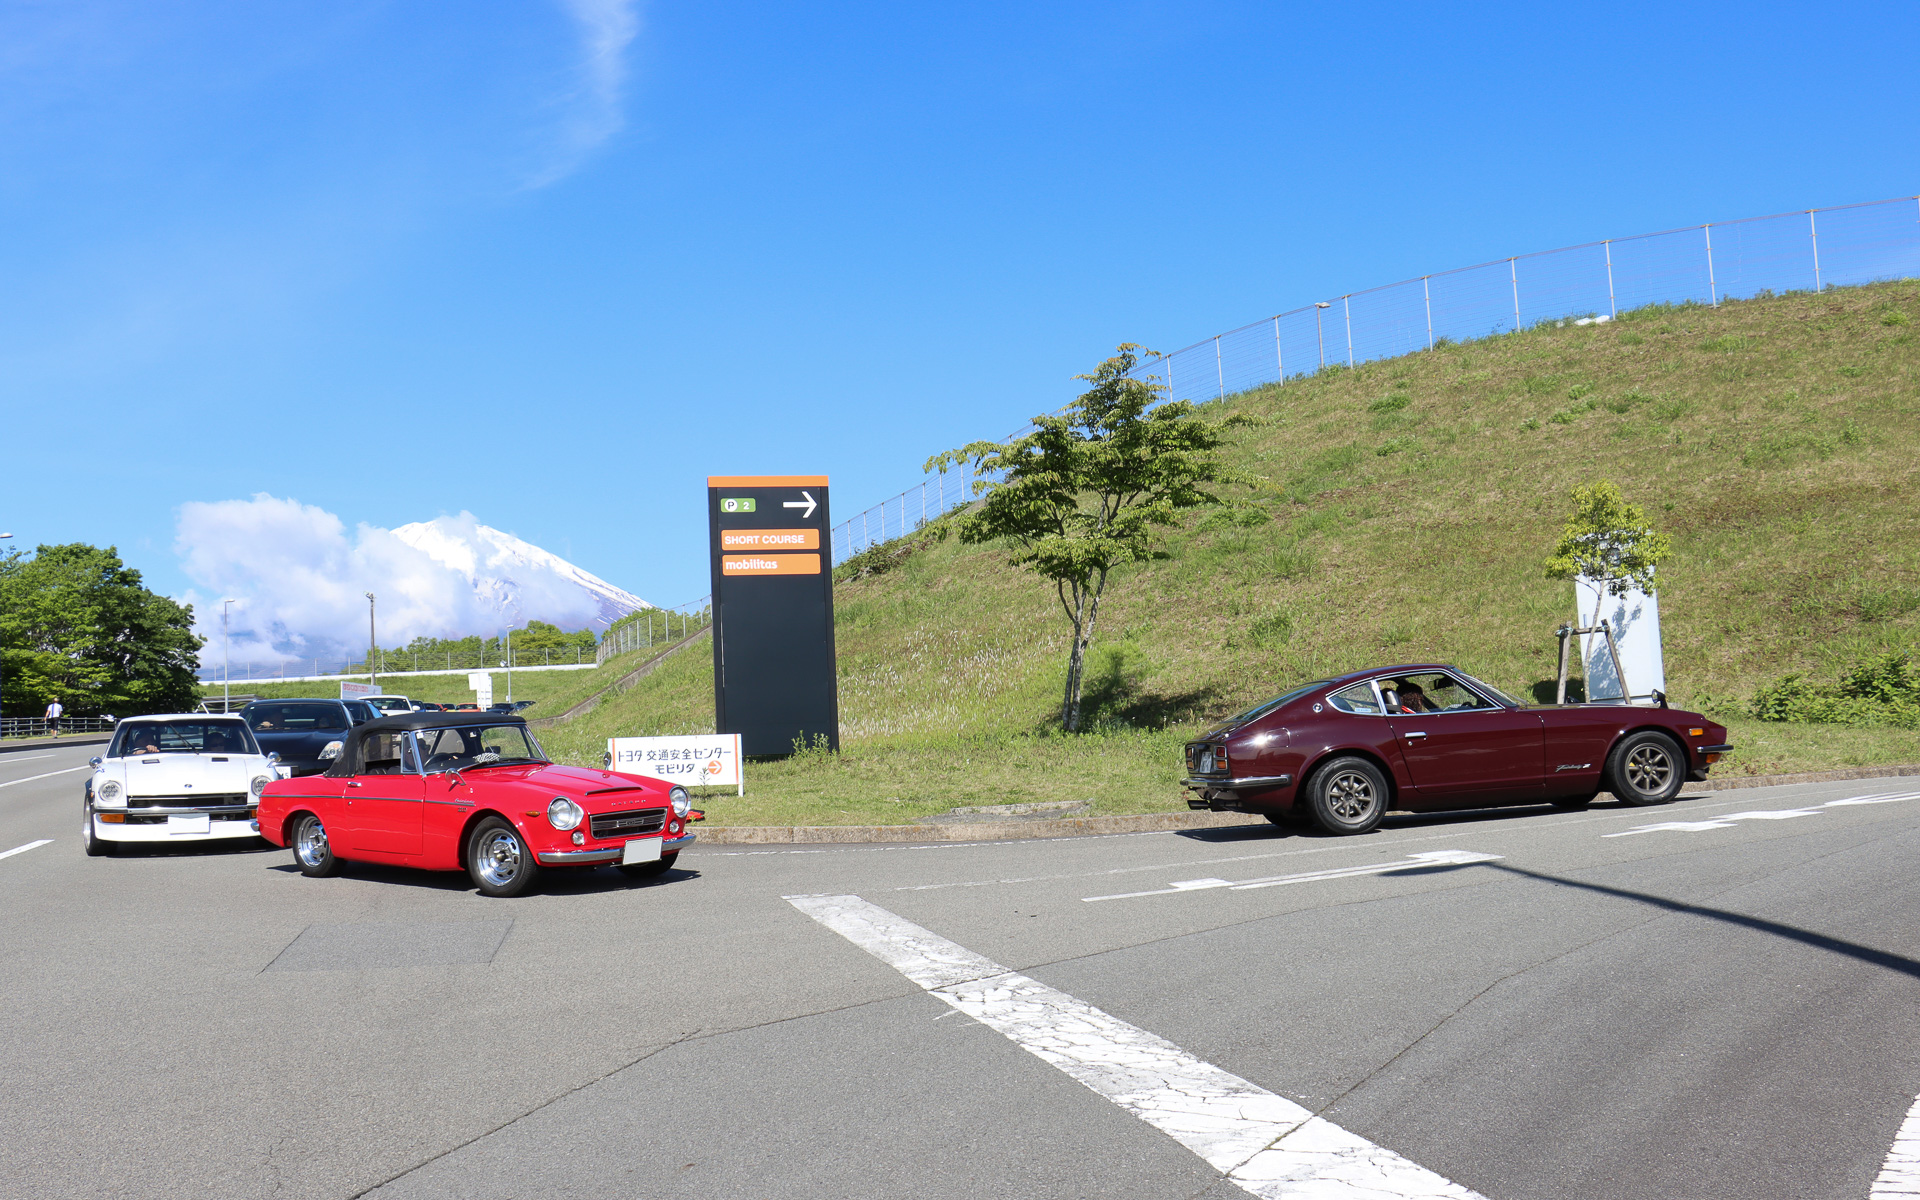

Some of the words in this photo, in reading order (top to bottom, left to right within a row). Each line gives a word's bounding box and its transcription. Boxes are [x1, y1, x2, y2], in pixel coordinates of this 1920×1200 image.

[727, 501, 735, 510] P
[743, 501, 750, 510] 2
[724, 535, 760, 545] SHORT
[762, 534, 805, 544] COURSE
[725, 558, 778, 570] mobilitas
[618, 750, 643, 762] トヨタ
[646, 747, 732, 761] 交通安全センター
[655, 763, 695, 775] モビリタ
